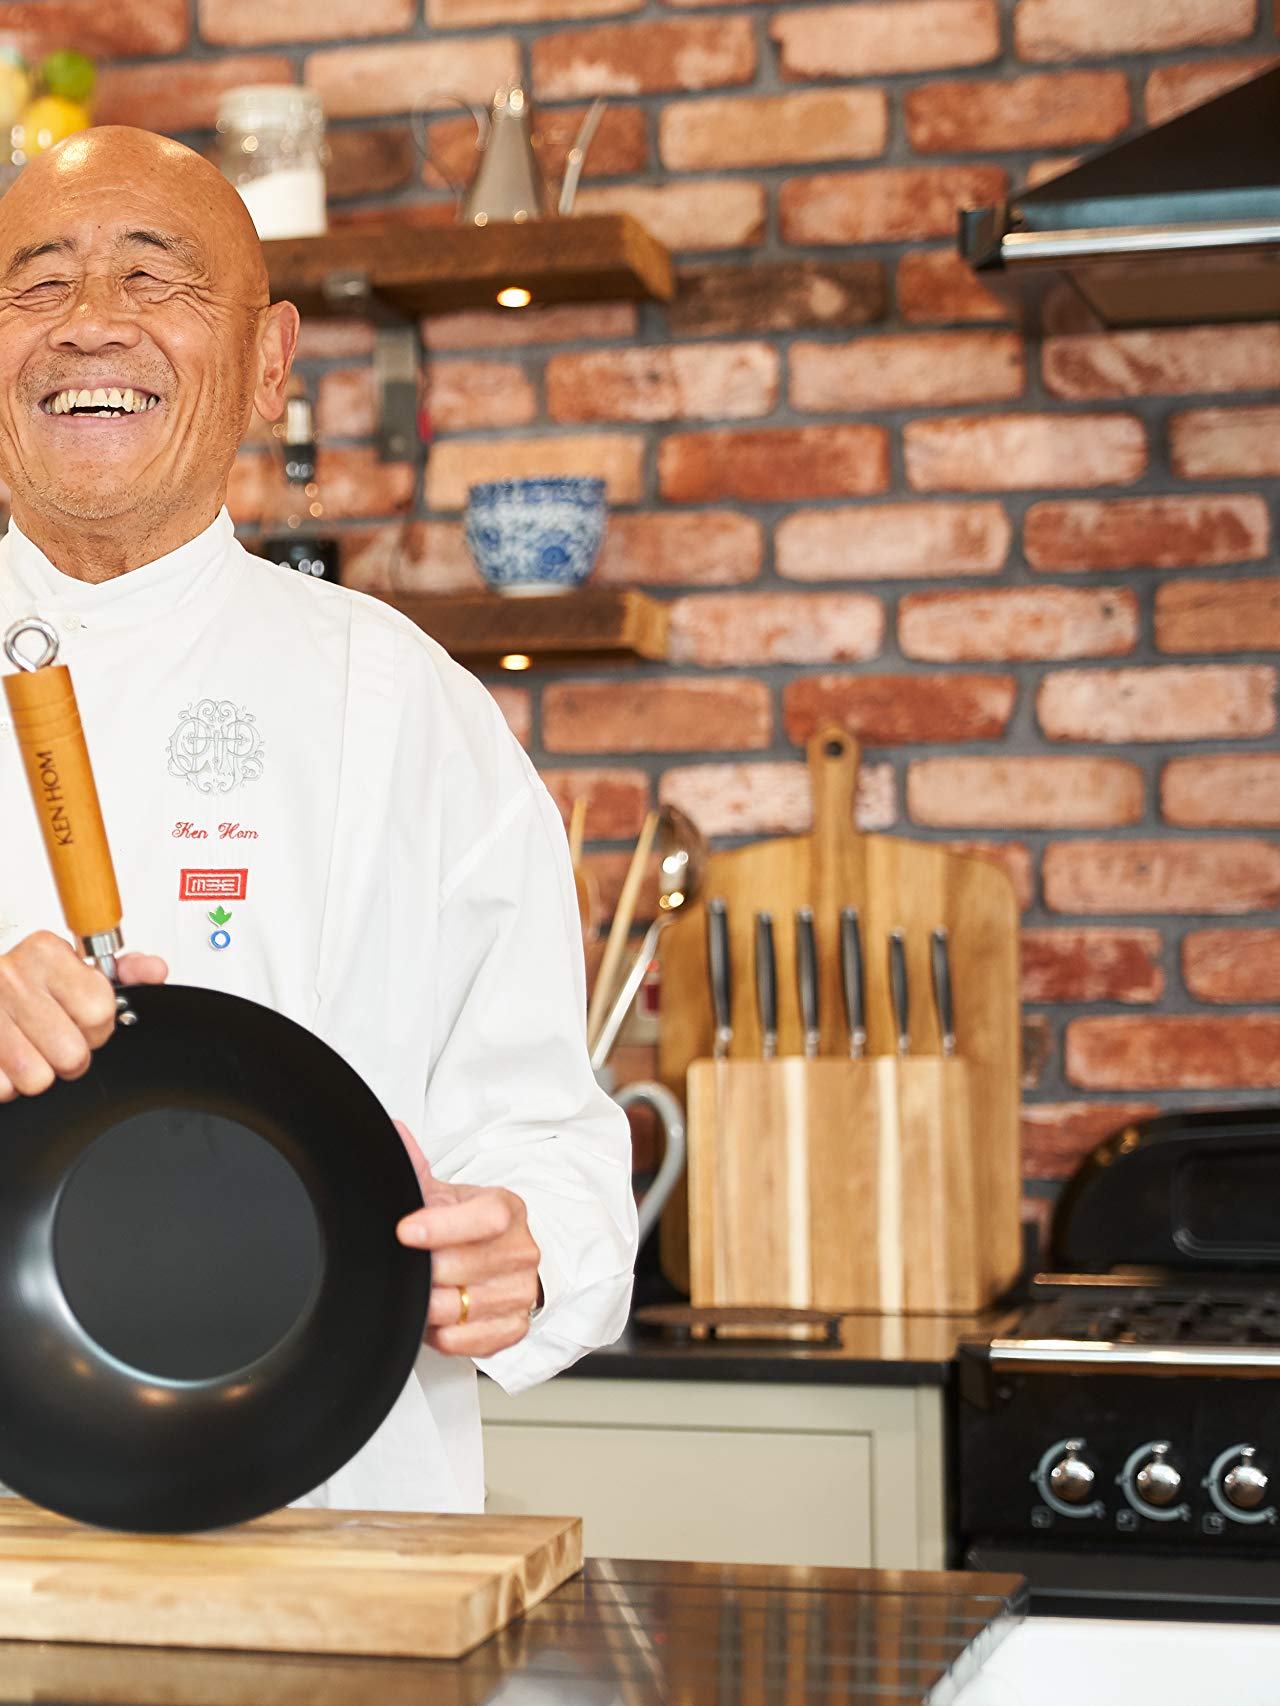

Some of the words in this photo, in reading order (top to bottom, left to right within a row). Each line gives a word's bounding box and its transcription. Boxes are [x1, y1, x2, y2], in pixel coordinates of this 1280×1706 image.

[36, 750, 63, 802] HOM
[49, 806, 74, 846] KEN
[172, 821, 208, 839] Ken
[218, 822, 259, 839] Hom
